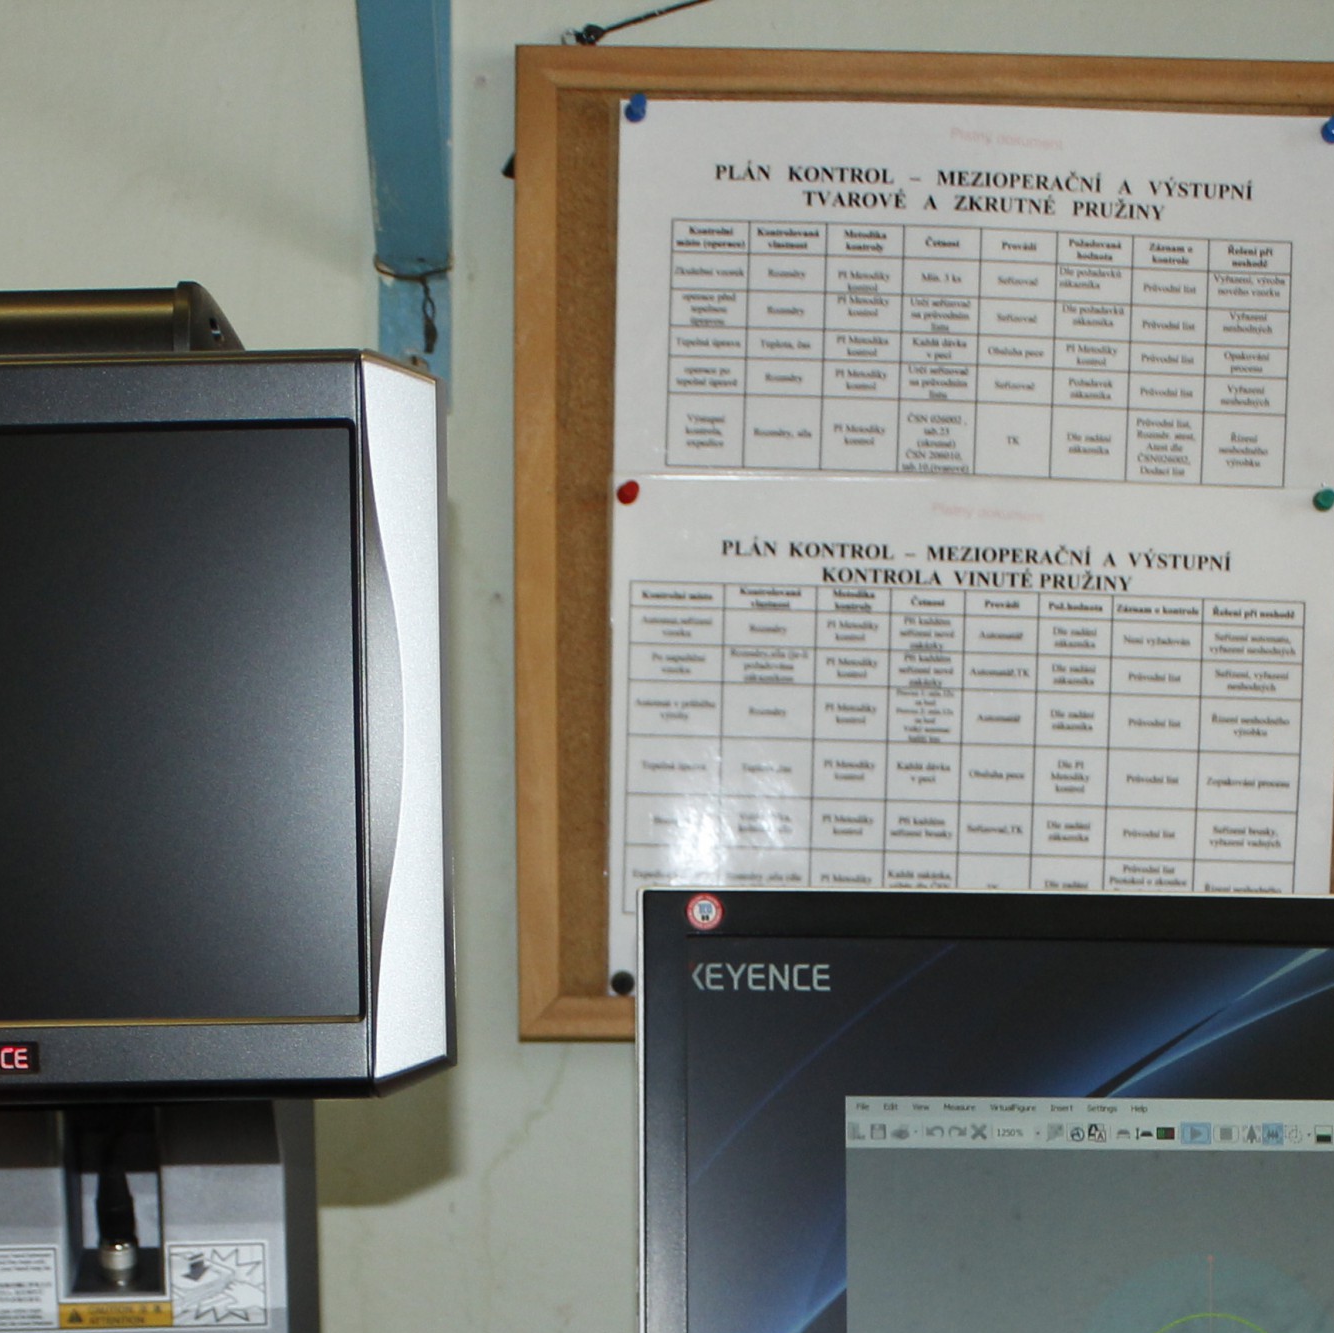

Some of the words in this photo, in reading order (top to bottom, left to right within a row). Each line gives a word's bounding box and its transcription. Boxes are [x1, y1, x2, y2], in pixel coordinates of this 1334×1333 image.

[715, 160, 770, 181] PLÁN
[788, 164, 894, 185] KONTROL
[937, 168, 1102, 194] MEZIOPERAČNÍ
[1118, 179, 1133, 196] A
[1149, 175, 1253, 202] VÝSTUPNÍ
[803, 187, 907, 210] TVAROVÉ
[923, 194, 938, 211] A
[954, 194, 1056, 216] ZKRUTNÉ
[1072, 198, 1166, 222] PRUŽINY
[721, 535, 777, 558] PLÁN
[789, 540, 894, 562] KONTROL
[927, 544, 1091, 568] MEZIOPERAČNÍ
[1103, 551, 1117, 568] A
[1128, 547, 1233, 573] VÝSTUPNÍ
[821, 566, 943, 587] KONTROLA
[953, 567, 1033, 590] VINUTÉ
[1040, 570, 1134, 593] PRUŽINY
[690, 962, 832, 992] KEYENCE
[883, 1102, 899, 1112] Edit
[943, 1102, 977, 1112] Measure
[1050, 1103, 1074, 1113] Insert
[1087, 1103, 1117, 1114] Settings
[1131, 1104, 1149, 1114] Help
